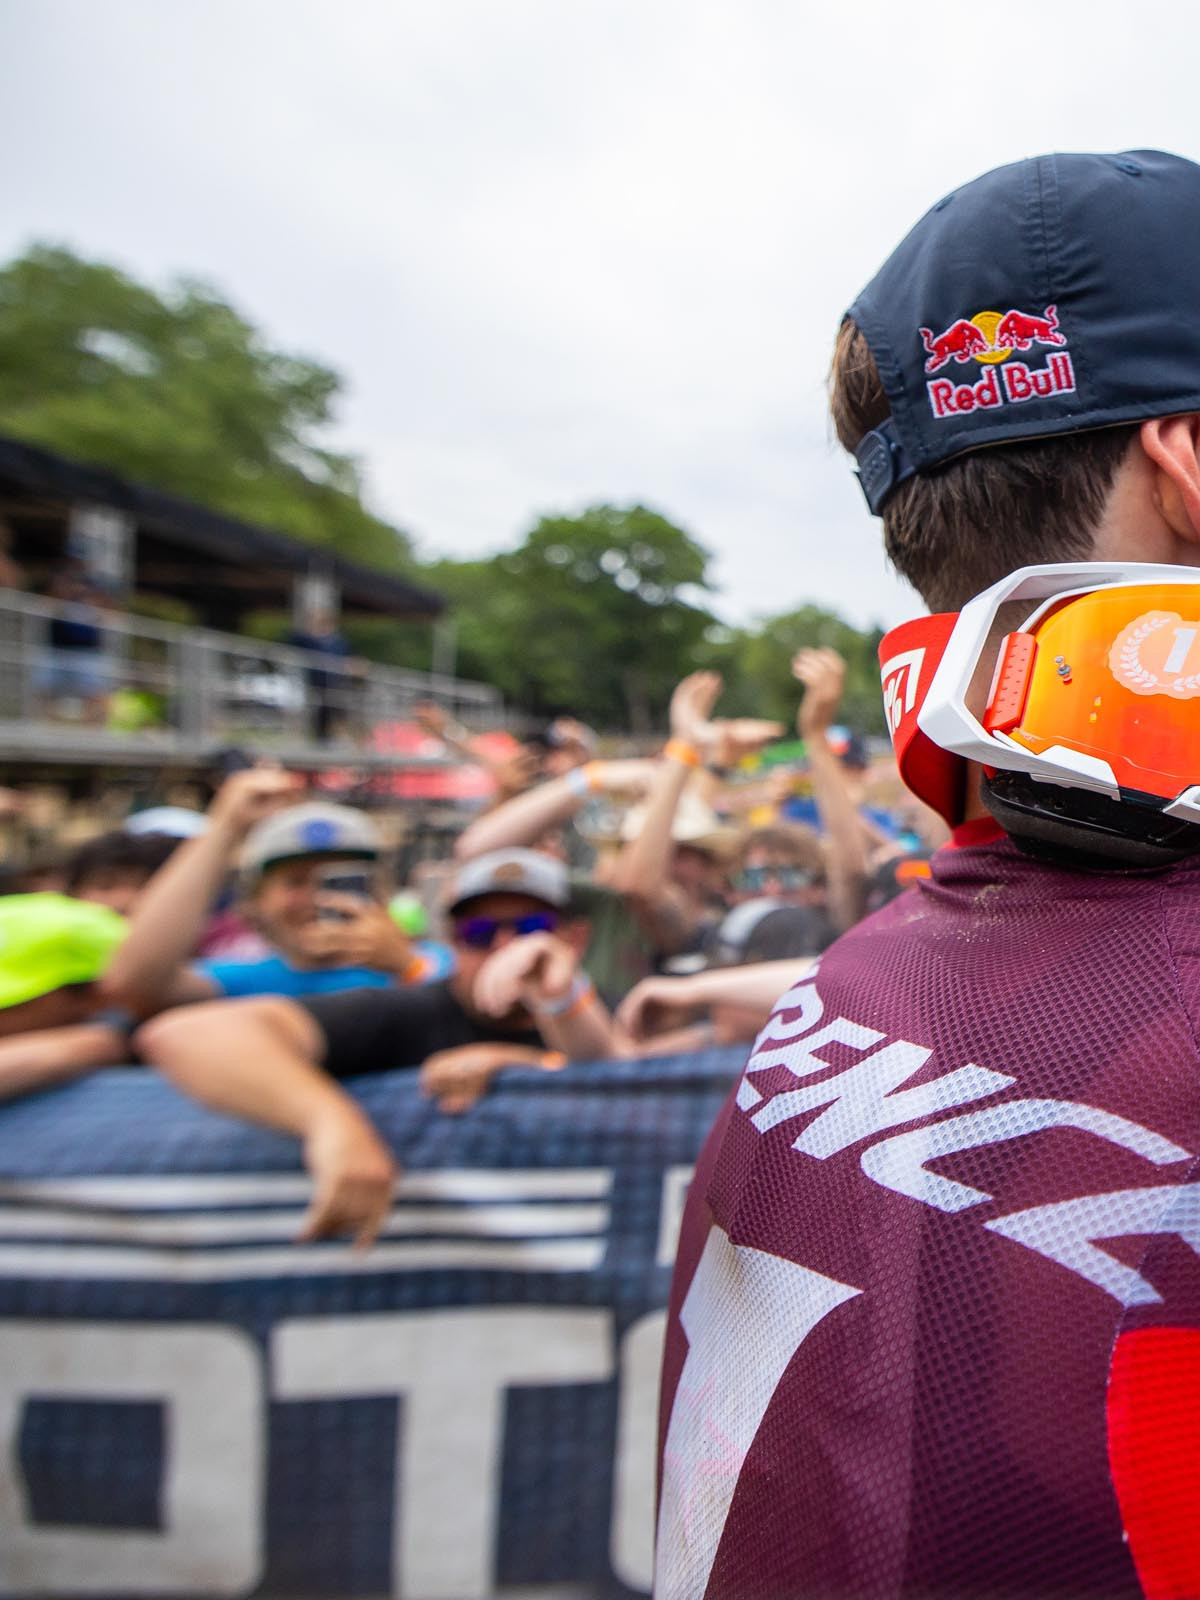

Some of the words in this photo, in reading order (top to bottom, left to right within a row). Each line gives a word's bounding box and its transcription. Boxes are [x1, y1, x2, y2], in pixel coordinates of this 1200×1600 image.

[928, 366, 1002, 418] Red
[1001, 351, 1075, 402] Bull
[1163, 628, 1197, 673] 1
[0, 1305, 668, 1597] OT
